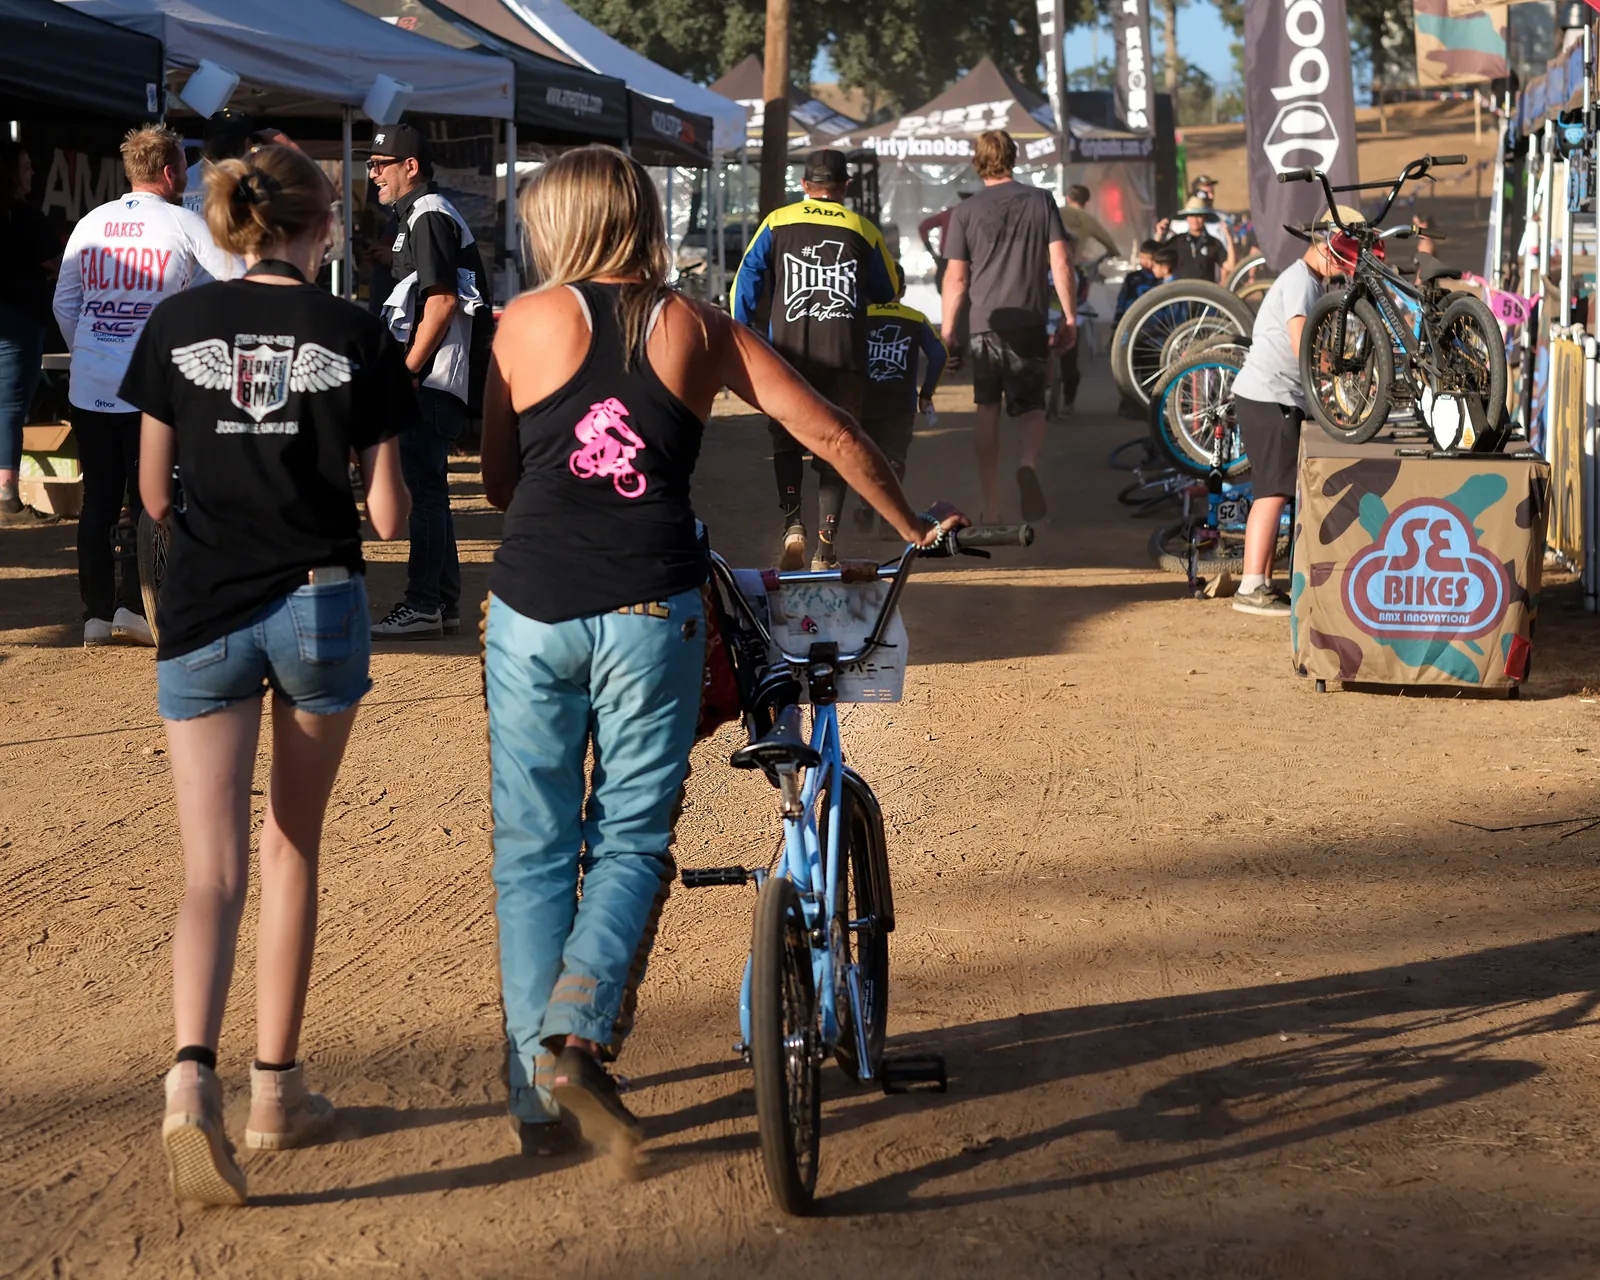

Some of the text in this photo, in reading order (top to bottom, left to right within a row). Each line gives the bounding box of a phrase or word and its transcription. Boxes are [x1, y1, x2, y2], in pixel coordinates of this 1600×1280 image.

[862, 136, 1021, 160] dirtyknobs.
[803, 206, 846, 218] SABA
[104, 221, 145, 238] OAKES
[81, 246, 172, 293] FACTORY
[84, 301, 153, 320] RACE
[1502, 300, 1524, 319] 59
[867, 335, 912, 371] OSS
[241, 382, 282, 408] BMX
[1220, 504, 1236, 520] 25
[1387, 518, 1466, 573] SE
[1383, 575, 1470, 607] BIKES
[1378, 612, 1471, 625] BMX INNOVATIONS
